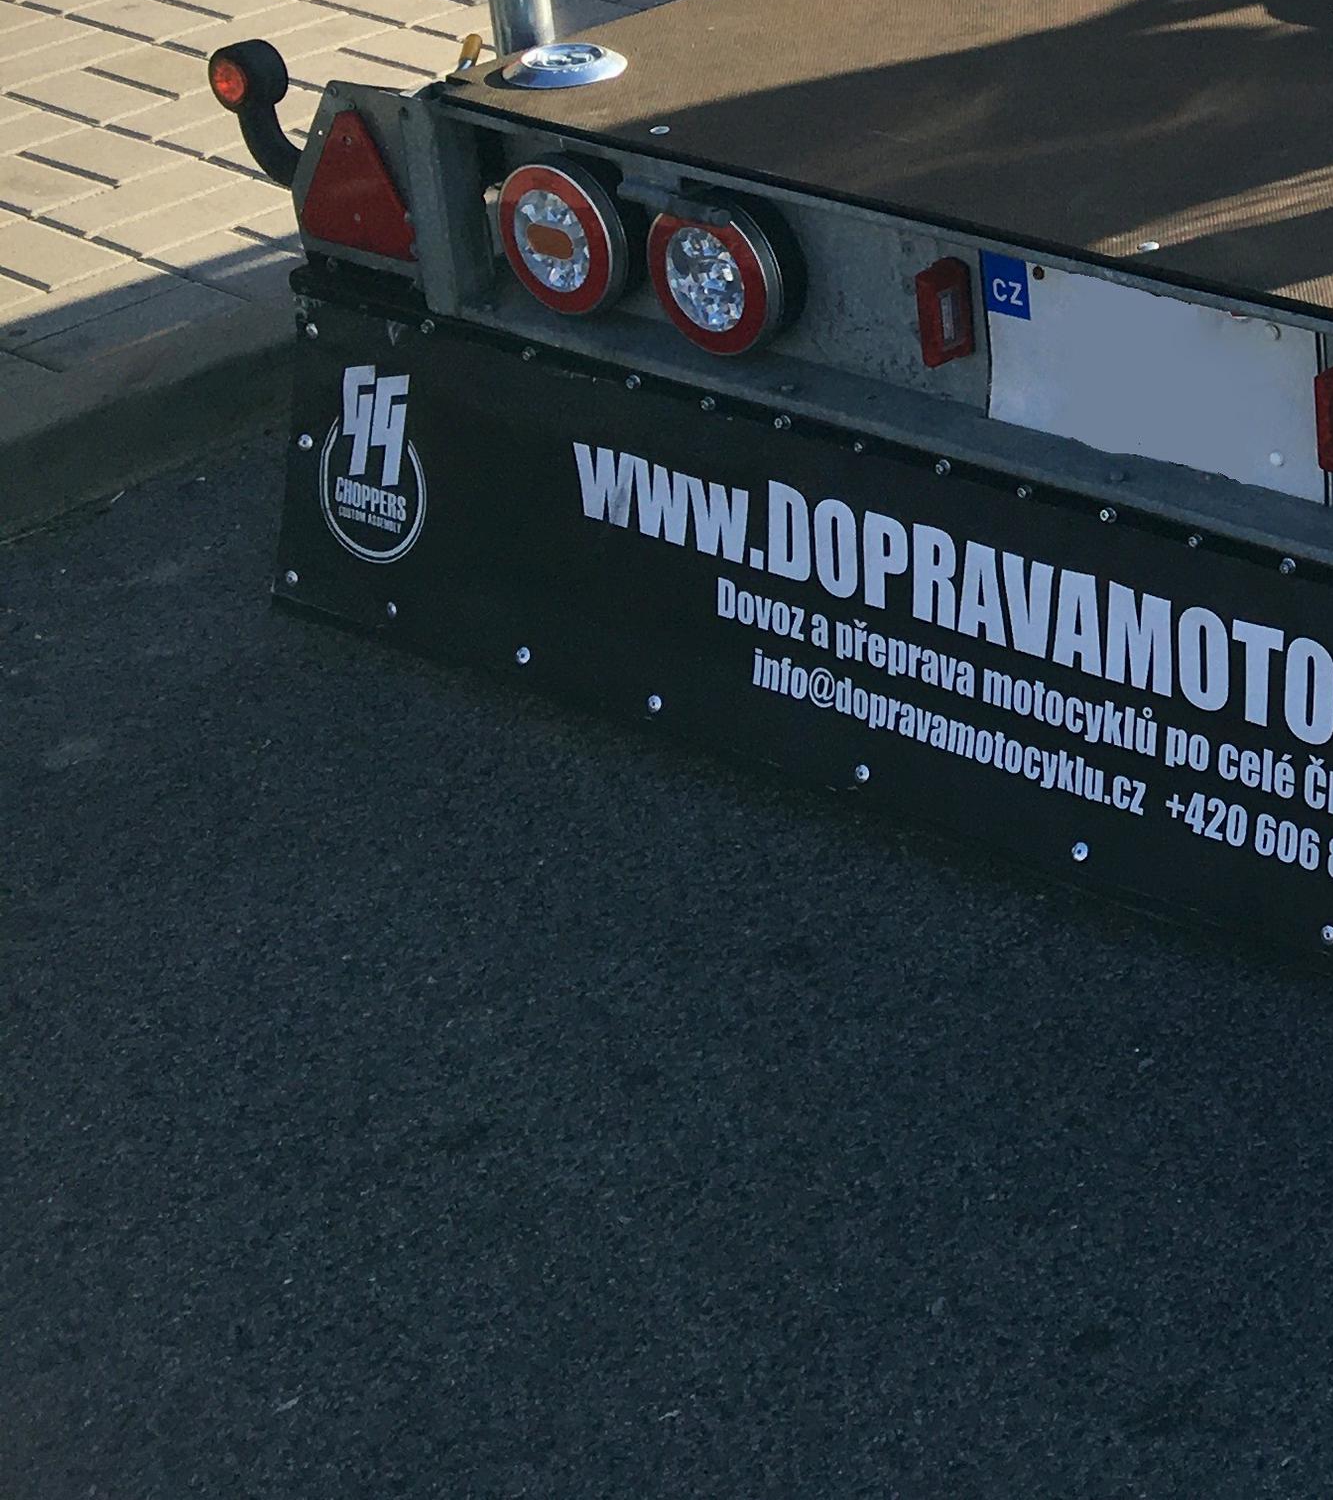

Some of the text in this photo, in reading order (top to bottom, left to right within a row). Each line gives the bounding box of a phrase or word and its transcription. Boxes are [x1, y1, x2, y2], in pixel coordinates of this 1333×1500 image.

[992, 277, 1024, 306] CZ
[335, 476, 407, 522] CHOPPERS
[717, 576, 805, 642] Dovoz
[811, 613, 829, 649] a
[835, 618, 975, 699] přeprava
[982, 667, 1158, 757] motocyklů
[1165, 725, 1210, 772] po
[1218, 743, 1295, 800] celé
[752, 647, 1147, 816] info@dopravamotocyklu.cz
[1165, 792, 1248, 848] +420
[1254, 813, 1320, 871] 606
